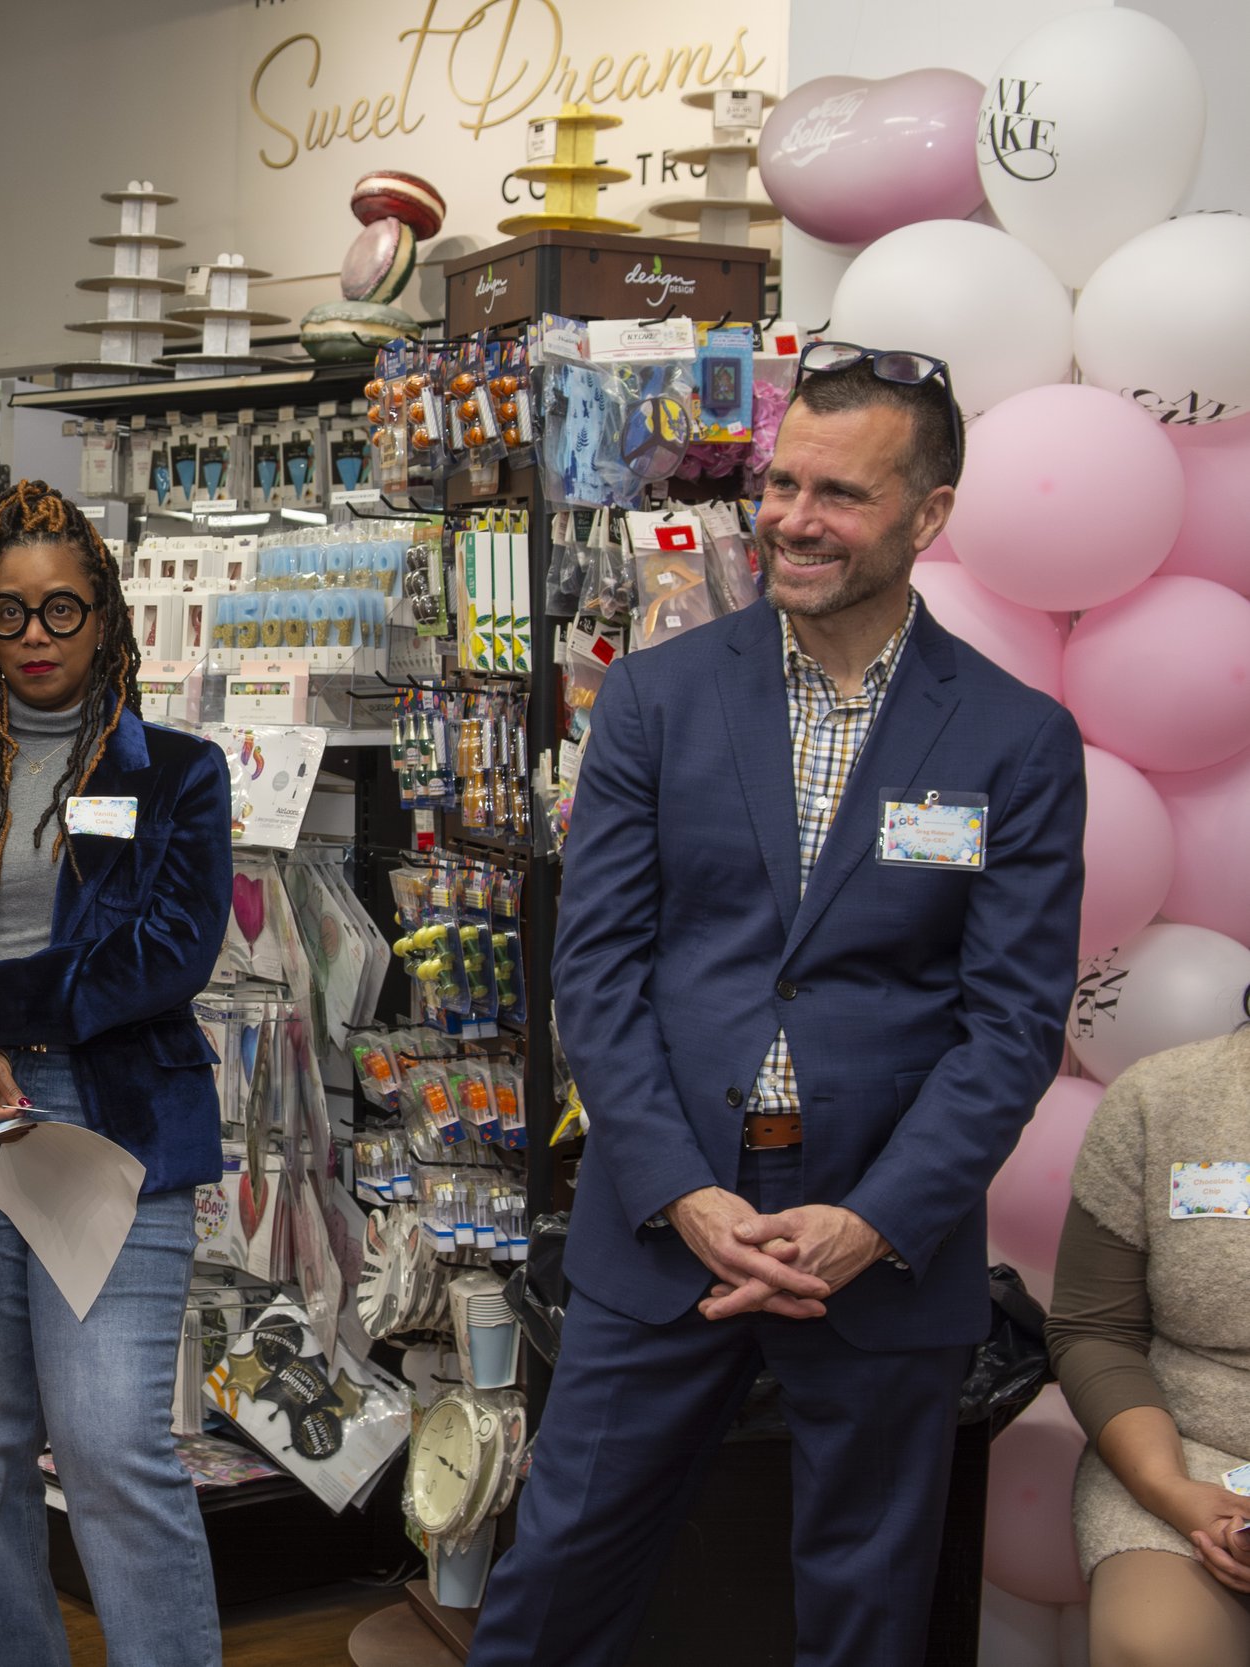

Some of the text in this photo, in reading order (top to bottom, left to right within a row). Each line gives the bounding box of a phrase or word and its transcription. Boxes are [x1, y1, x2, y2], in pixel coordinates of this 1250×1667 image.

[250, 0, 766, 169] Sweet Dreams
[780, 118, 838, 168] Belly
[625, 263, 696, 306] design
[899, 816, 920, 826] obt
[255, 1332, 298, 1355] PERFECTION
[278, 1369, 318, 1404] BIRTHDAY
[292, 1369, 317, 1391] HAPPY
[302, 1415, 324, 1455] BIRTHDAY
